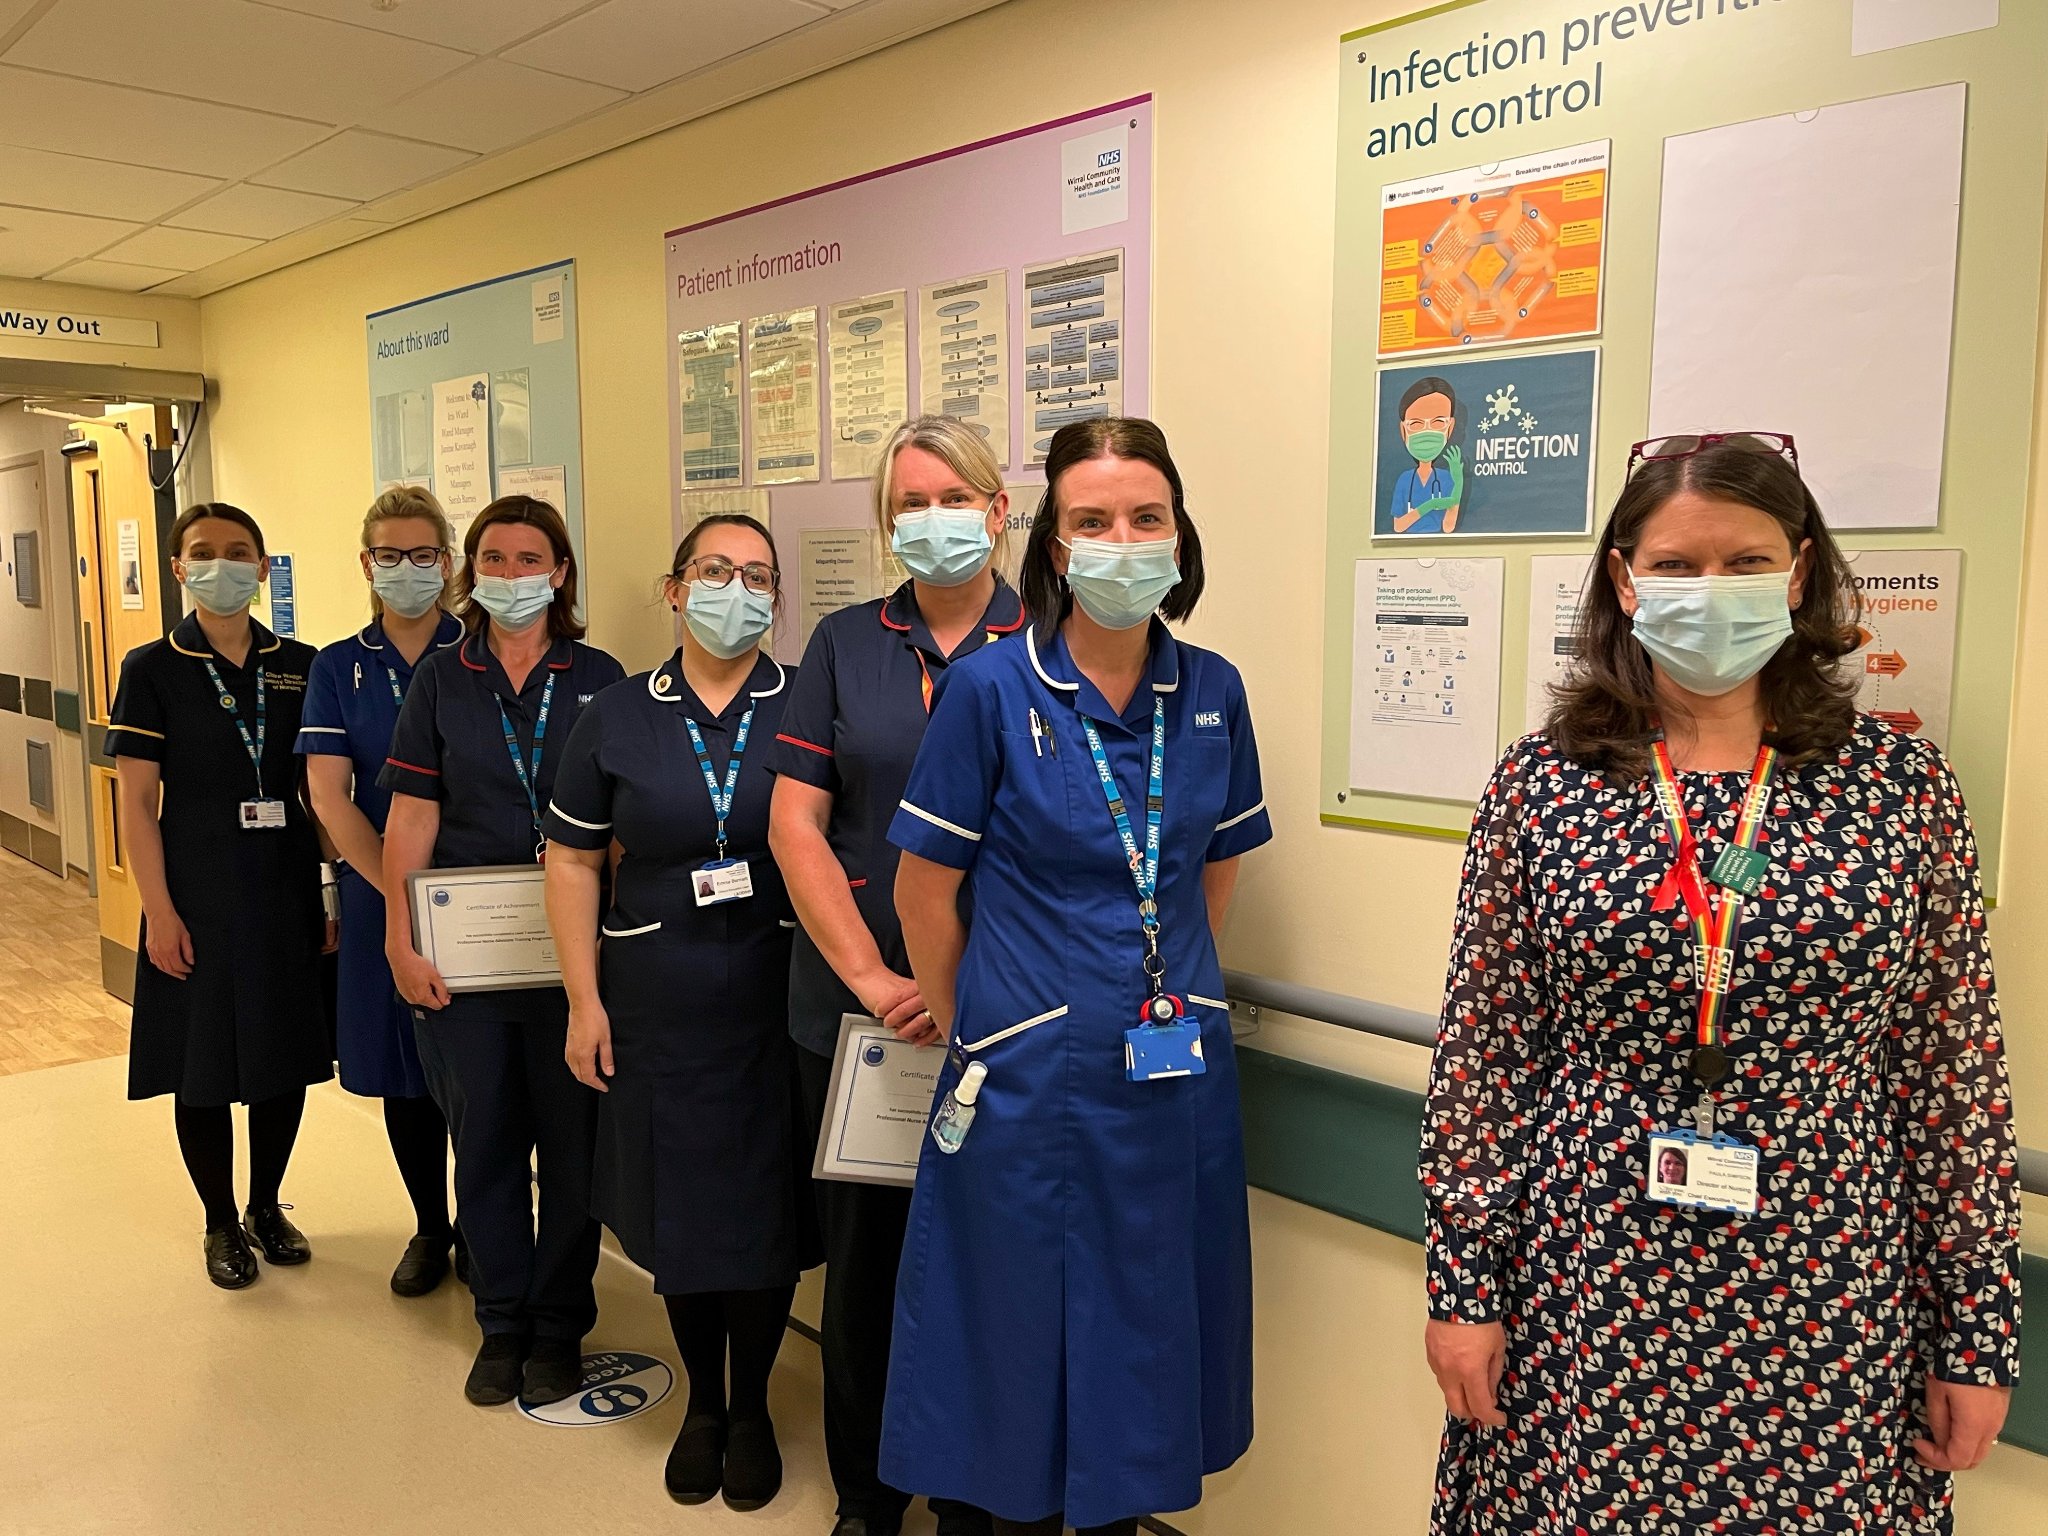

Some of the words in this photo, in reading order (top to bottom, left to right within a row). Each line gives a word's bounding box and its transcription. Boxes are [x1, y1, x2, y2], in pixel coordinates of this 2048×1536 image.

[1370, 31, 1546, 103] Infection
[1366, 102, 1438, 158] and
[1451, 62, 1602, 138] control
[1098, 150, 1120, 167] NHS
[1515, 165, 1541, 177] Breaking
[1553, 161, 1570, 169] chain
[1578, 154, 1605, 164] infection
[1067, 174, 1085, 186] Wirral
[1086, 166, 1120, 181] Community
[1073, 182, 1093, 192] Health
[1094, 178, 1106, 187] and
[1106, 175, 1120, 184] Care
[678, 264, 732, 299] Patient
[737, 240, 841, 285] information
[0, 312, 48, 335] Way
[57, 316, 101, 335] Out
[377, 340, 405, 359] About
[406, 330, 423, 353] this
[424, 322, 449, 348] ward
[1476, 434, 1579, 460] INFECTION
[1475, 462, 1528, 476] CONTROL
[1869, 658, 1879, 670] 4
[539, 706, 548, 722] NHS
[1155, 695, 1164, 717] NHS
[741, 710, 752, 724] NHS
[1195, 712, 1221, 727] NHS
[690, 729, 702, 742] NHS
[736, 728, 747, 742] NHS
[1086, 728, 1101, 751] NHS
[1154, 724, 1164, 747] NHS
[1096, 759, 1112, 783] NHS
[1151, 755, 1162, 779] NHS
[705, 771, 718, 788] NHS
[726, 769, 738, 787] NHS
[721, 793, 732, 811] NHS
[1655, 783, 1683, 818] NHS
[1743, 784, 1772, 822] NHS
[1147, 825, 1159, 850] NHS
[1146, 859, 1157, 884] NHS
[1718, 850, 1738, 878] Champion
[1729, 857, 1743, 873] Speak
[1734, 857, 1752, 881] Freedom
[1723, 874, 1733, 884] Up
[1707, 947, 1734, 994] NHS
[900, 1070, 935, 1080] Certificate
[1734, 1151, 1754, 1160] NHS
[1696, 1180, 1720, 1188] Director
[1729, 1184, 1751, 1194] Nursing
[1704, 1194, 1730, 1203] Executive
[582, 1354, 619, 1369] the
